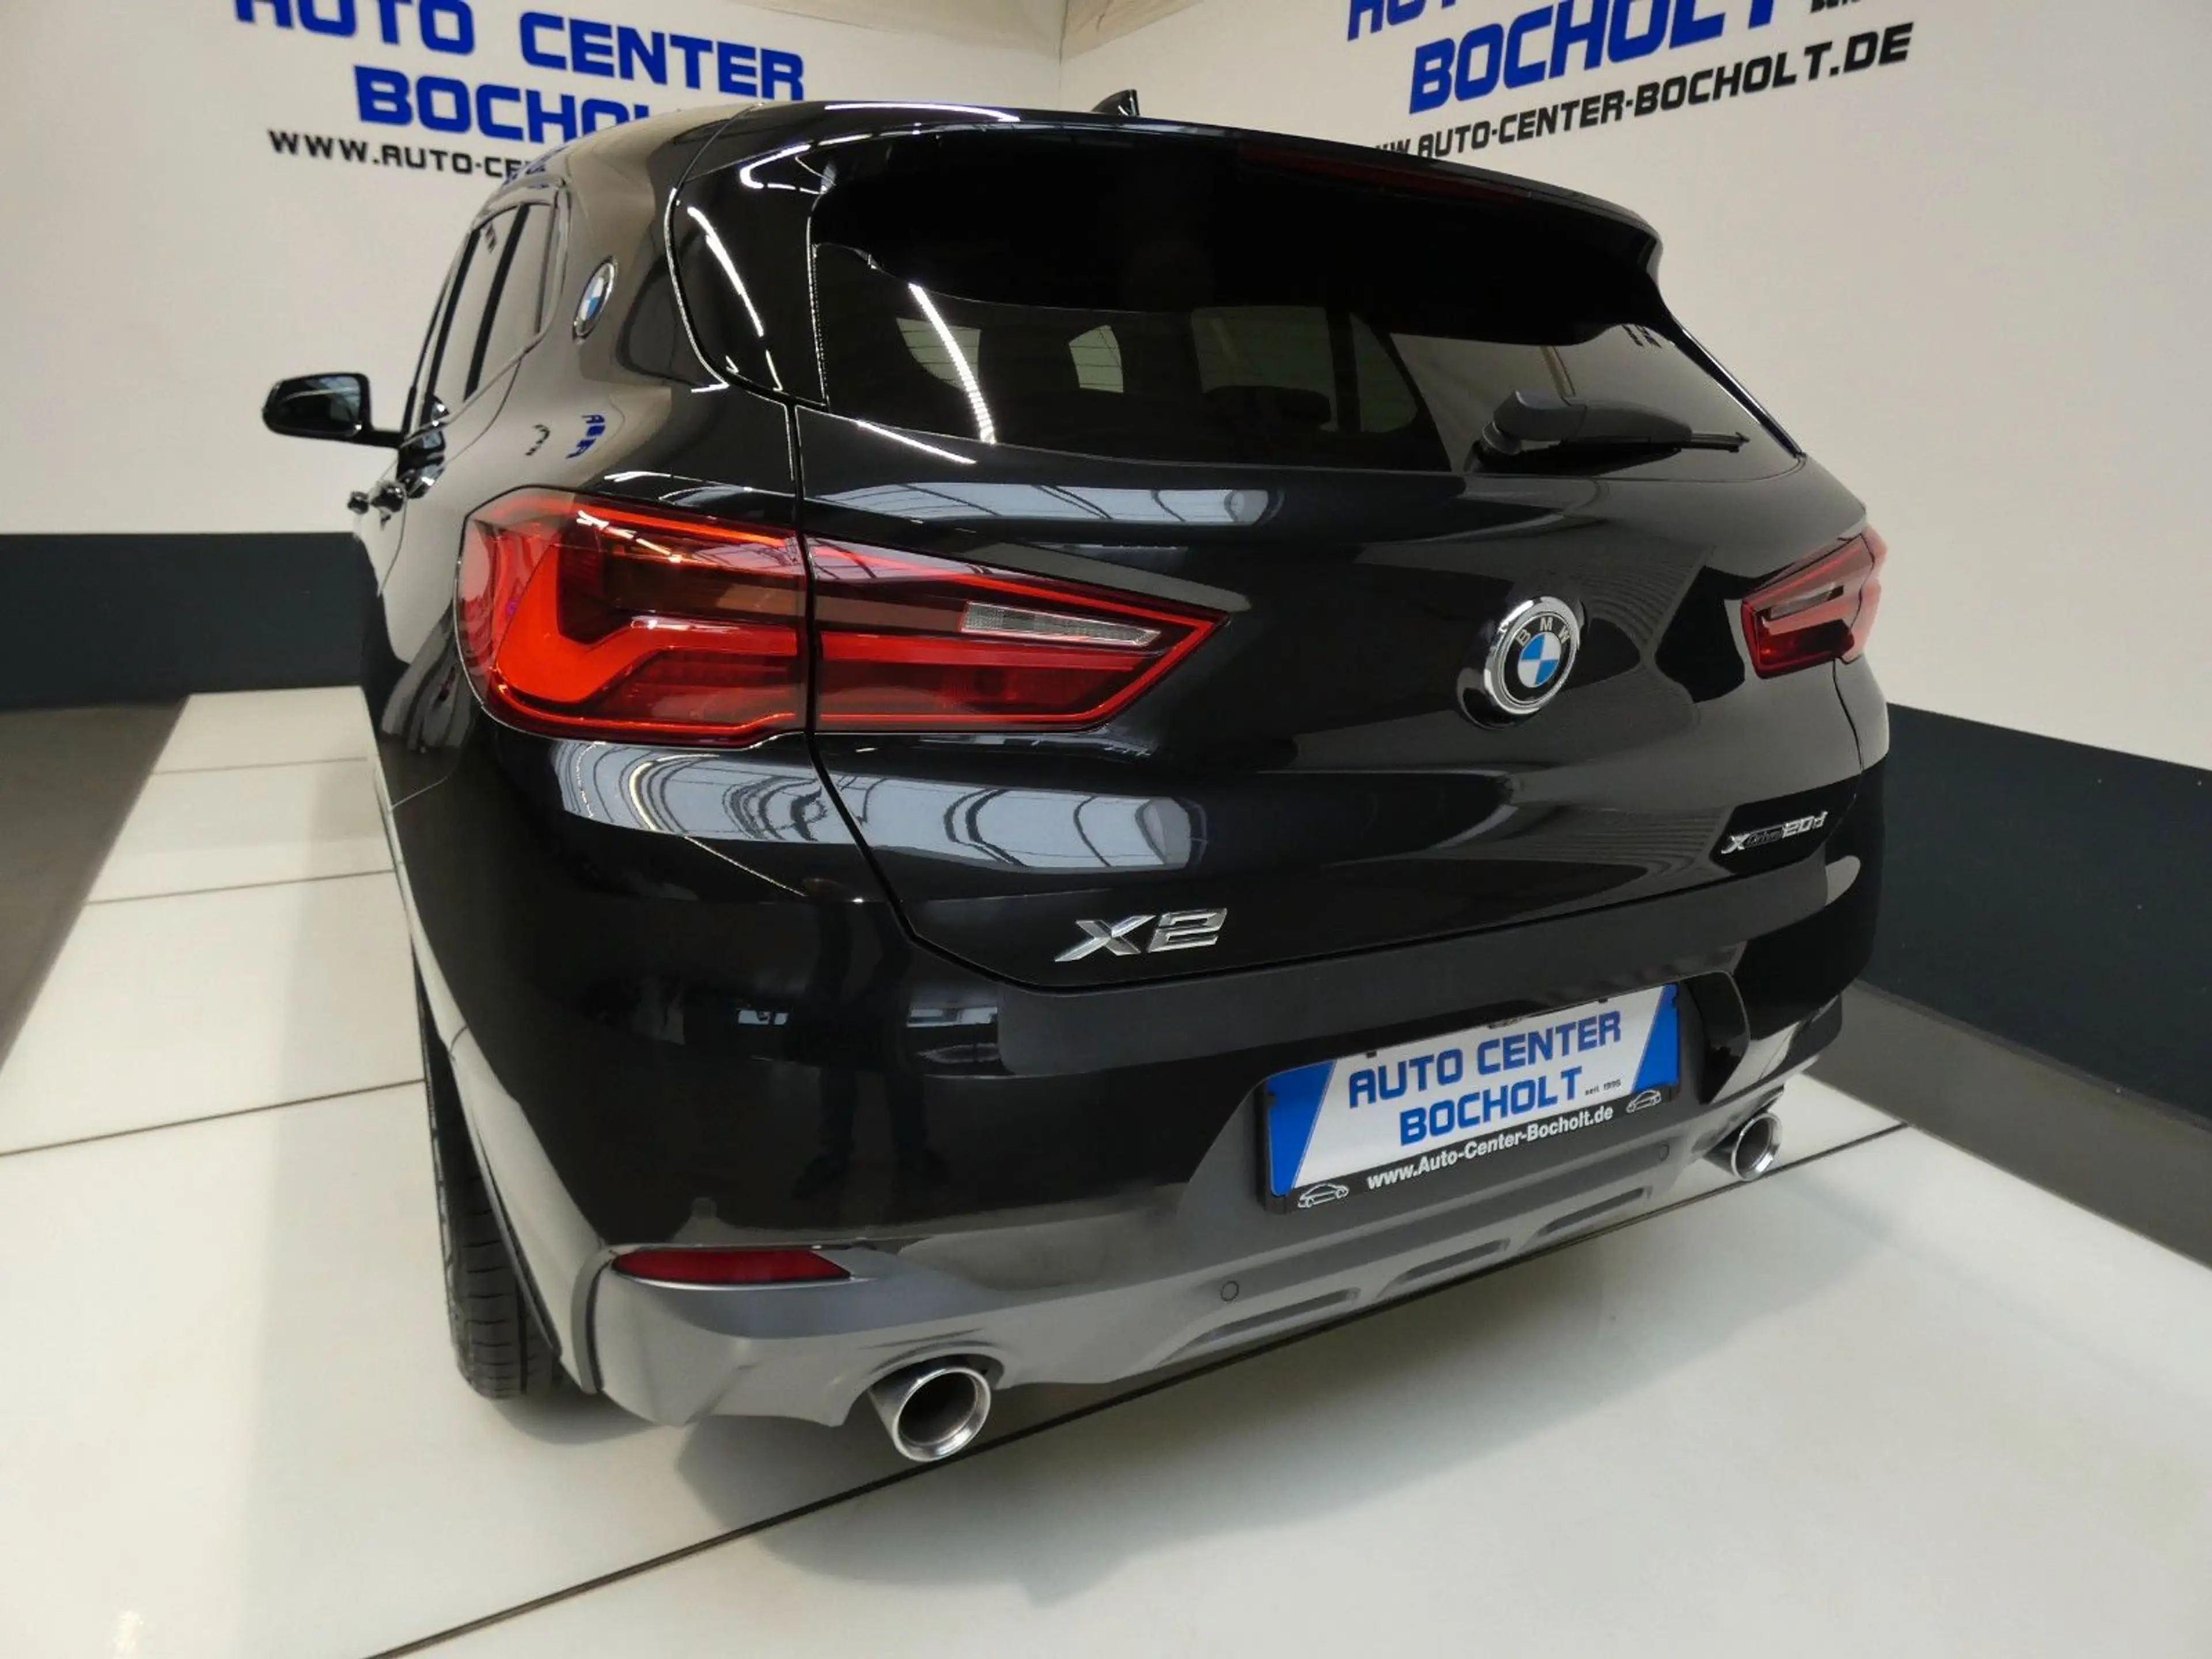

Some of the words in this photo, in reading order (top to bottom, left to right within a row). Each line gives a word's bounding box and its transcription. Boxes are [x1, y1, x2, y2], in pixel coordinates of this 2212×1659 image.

[520, 12, 804, 101] CENTER
[353, 65, 649, 143] BOCHO
[268, 130, 531, 178] WWW.AUTO-CE
[1515, 616, 1571, 647] BMW
[1055, 908, 1228, 963] X2
[1349, 1048, 1464, 1108] AUTO
[1476, 1010, 1622, 1075] CENTER
[1400, 1066, 1582, 1146] BOCHOLT
[1366, 1104, 1613, 1190] www.Auto-Center-Bocholt.de
